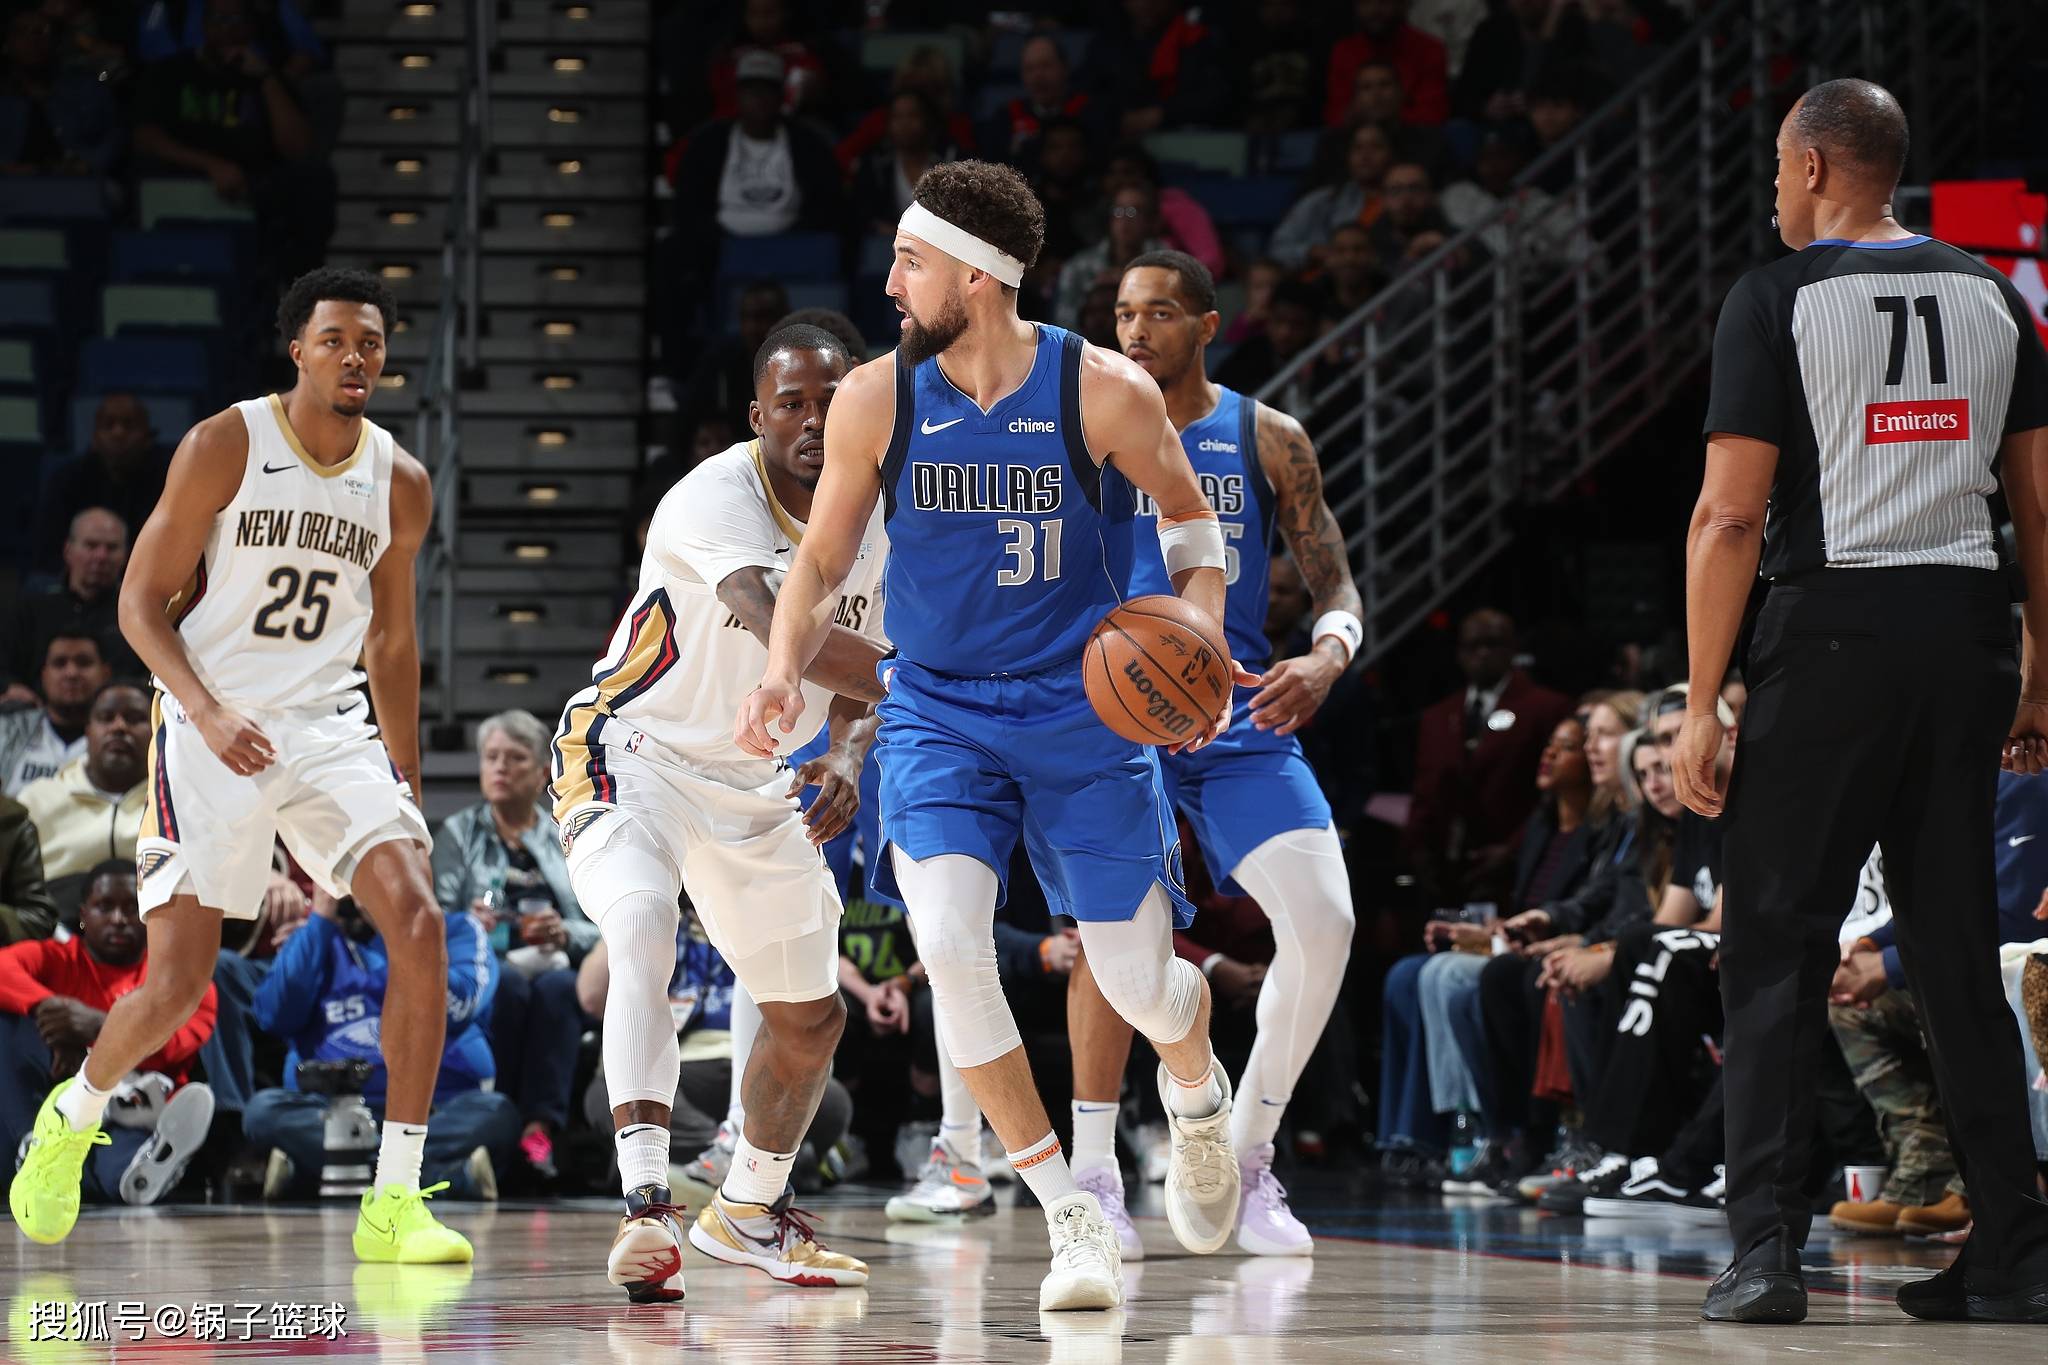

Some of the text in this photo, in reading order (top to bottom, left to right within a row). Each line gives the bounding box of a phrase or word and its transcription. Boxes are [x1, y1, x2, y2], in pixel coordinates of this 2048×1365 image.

[1873, 295, 1947, 385] 71
[1009, 418, 1055, 433] chime
[1199, 438, 1237, 454] chime
[1873, 411, 1958, 433] Emirates
[913, 462, 1061, 513] DALLAS
[235, 509, 378, 570] NEW ORLEANS
[998, 518, 1063, 586] 31
[253, 565, 338, 642] 25
[1124, 659, 1195, 736] Wilson
